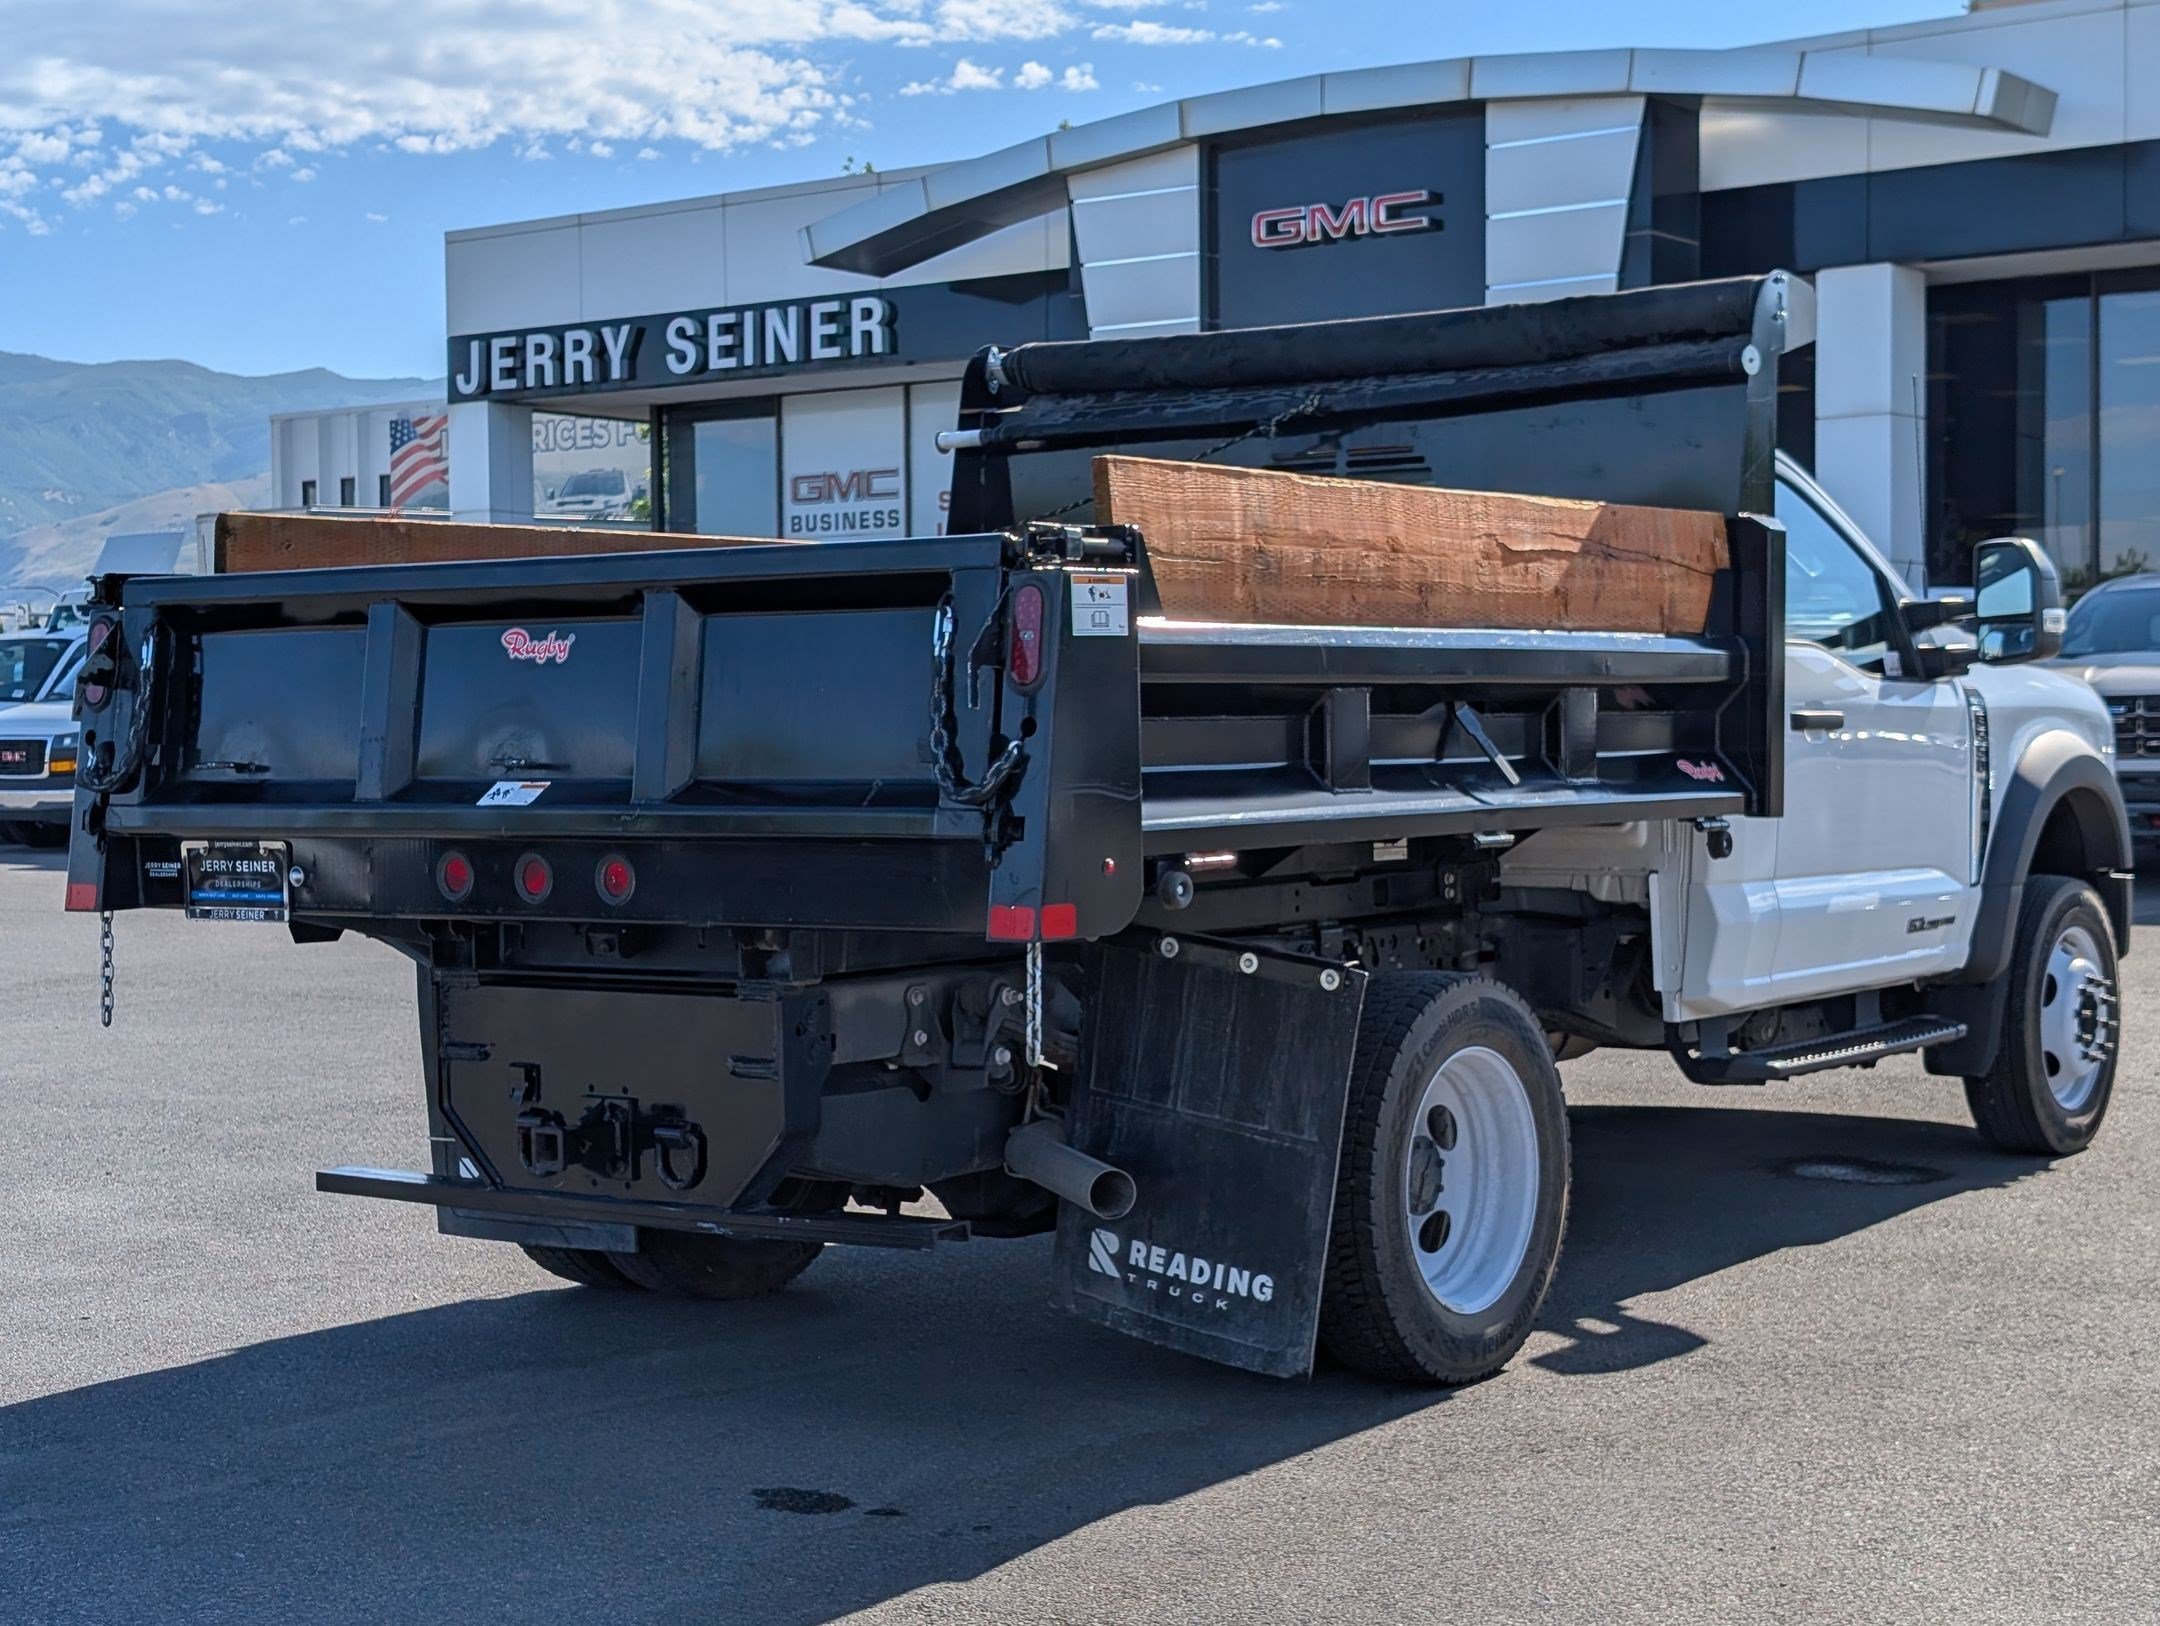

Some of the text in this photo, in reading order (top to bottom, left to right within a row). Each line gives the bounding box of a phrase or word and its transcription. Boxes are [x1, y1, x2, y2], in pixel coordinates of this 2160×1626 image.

[1251, 189, 1429, 248] GMC
[455, 297, 884, 395] JERRY SEINER
[532, 418, 612, 453] RICES
[791, 468, 899, 506] GMC
[791, 508, 900, 534] BUSINESS
[501, 627, 577, 665] Rugby
[200, 860, 276, 873] JERRY SEINER
[215, 879, 262, 889] DEALERSHIPS
[209, 909, 265, 920] JERRY SEINER
[1128, 1239, 1275, 1302] READING
[1127, 1272, 1230, 1311] TRUCK
